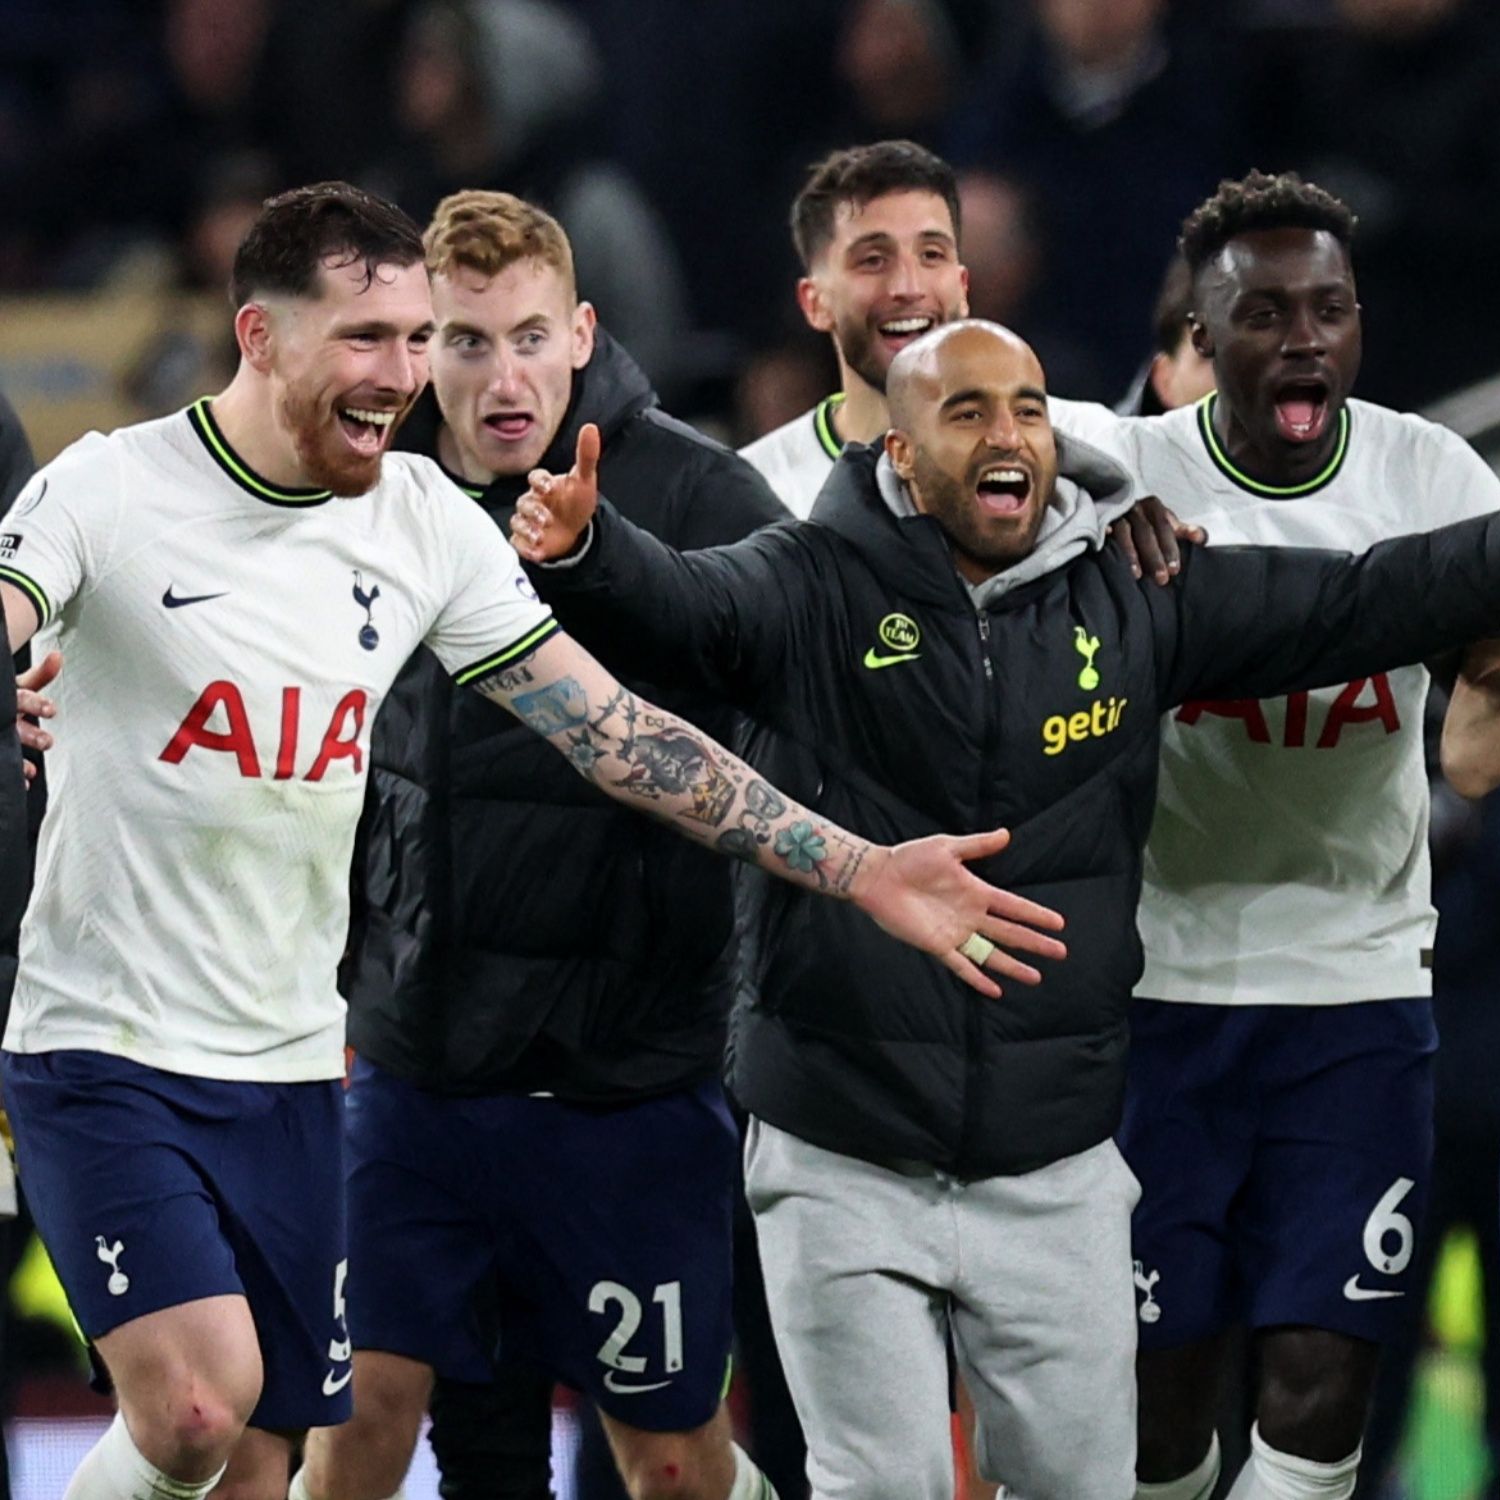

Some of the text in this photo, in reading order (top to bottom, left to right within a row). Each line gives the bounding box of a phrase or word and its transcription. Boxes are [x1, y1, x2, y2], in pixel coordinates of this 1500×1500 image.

[158, 680, 367, 782] AIA
[1043, 697, 1128, 756] getir
[1363, 1177, 1416, 1276] 6
[587, 1280, 684, 1374] 21
